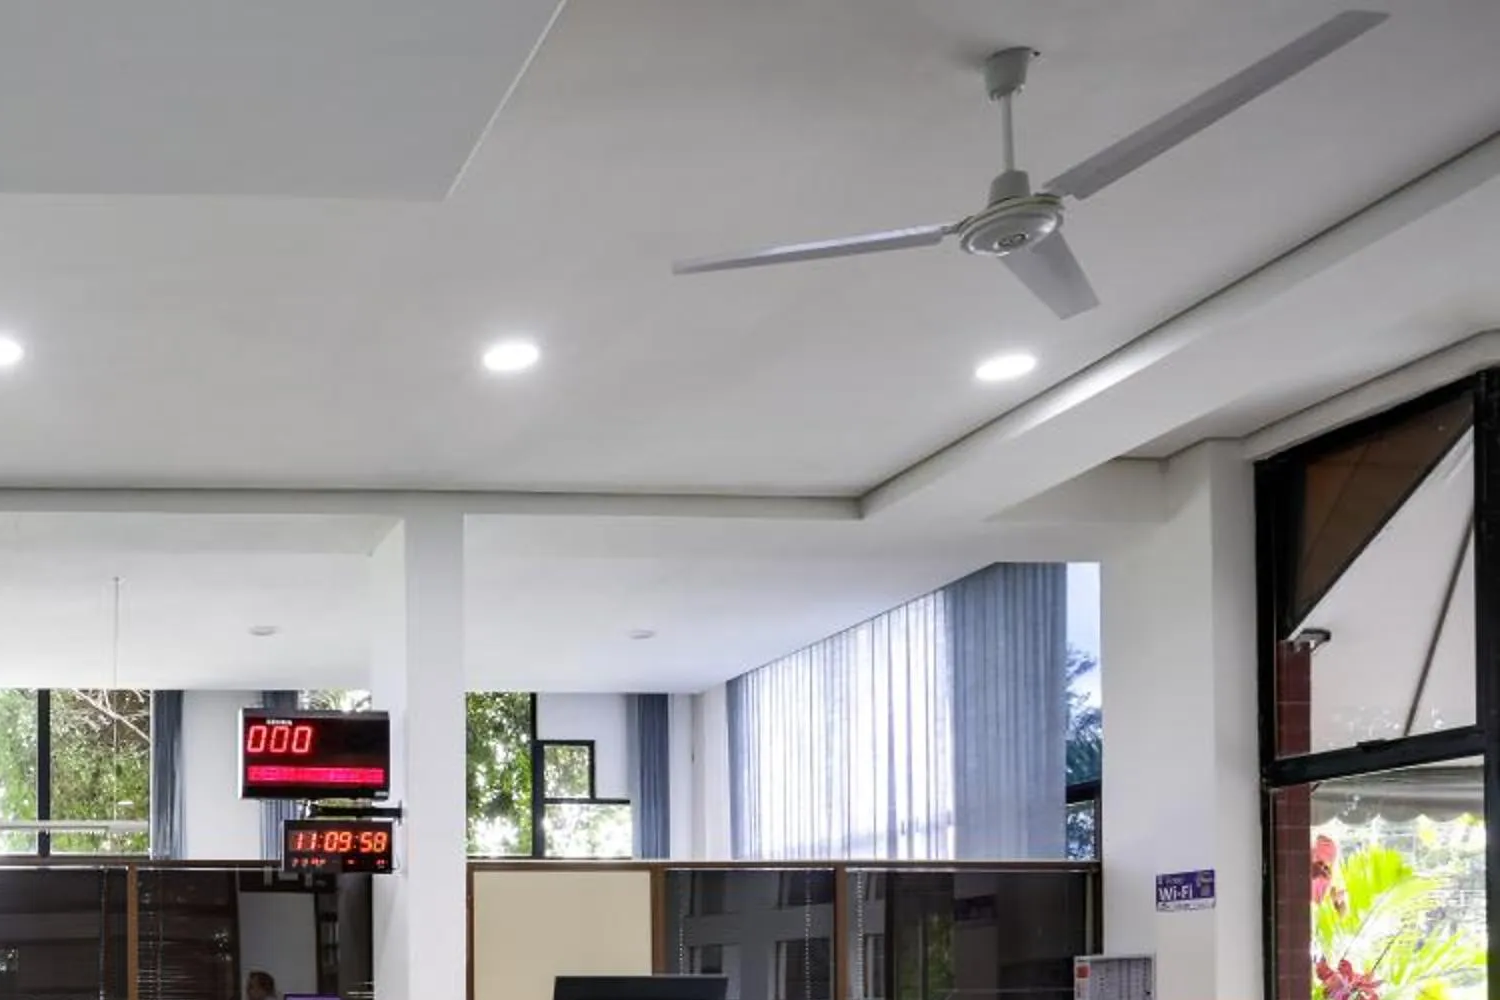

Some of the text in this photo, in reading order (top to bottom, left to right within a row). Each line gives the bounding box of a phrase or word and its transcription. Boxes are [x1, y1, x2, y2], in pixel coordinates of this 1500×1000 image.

[247, 725, 312, 753] 000
[296, 831, 388, 852] 11:09:58
[1158, 884, 1193, 901] Wi-Fi
